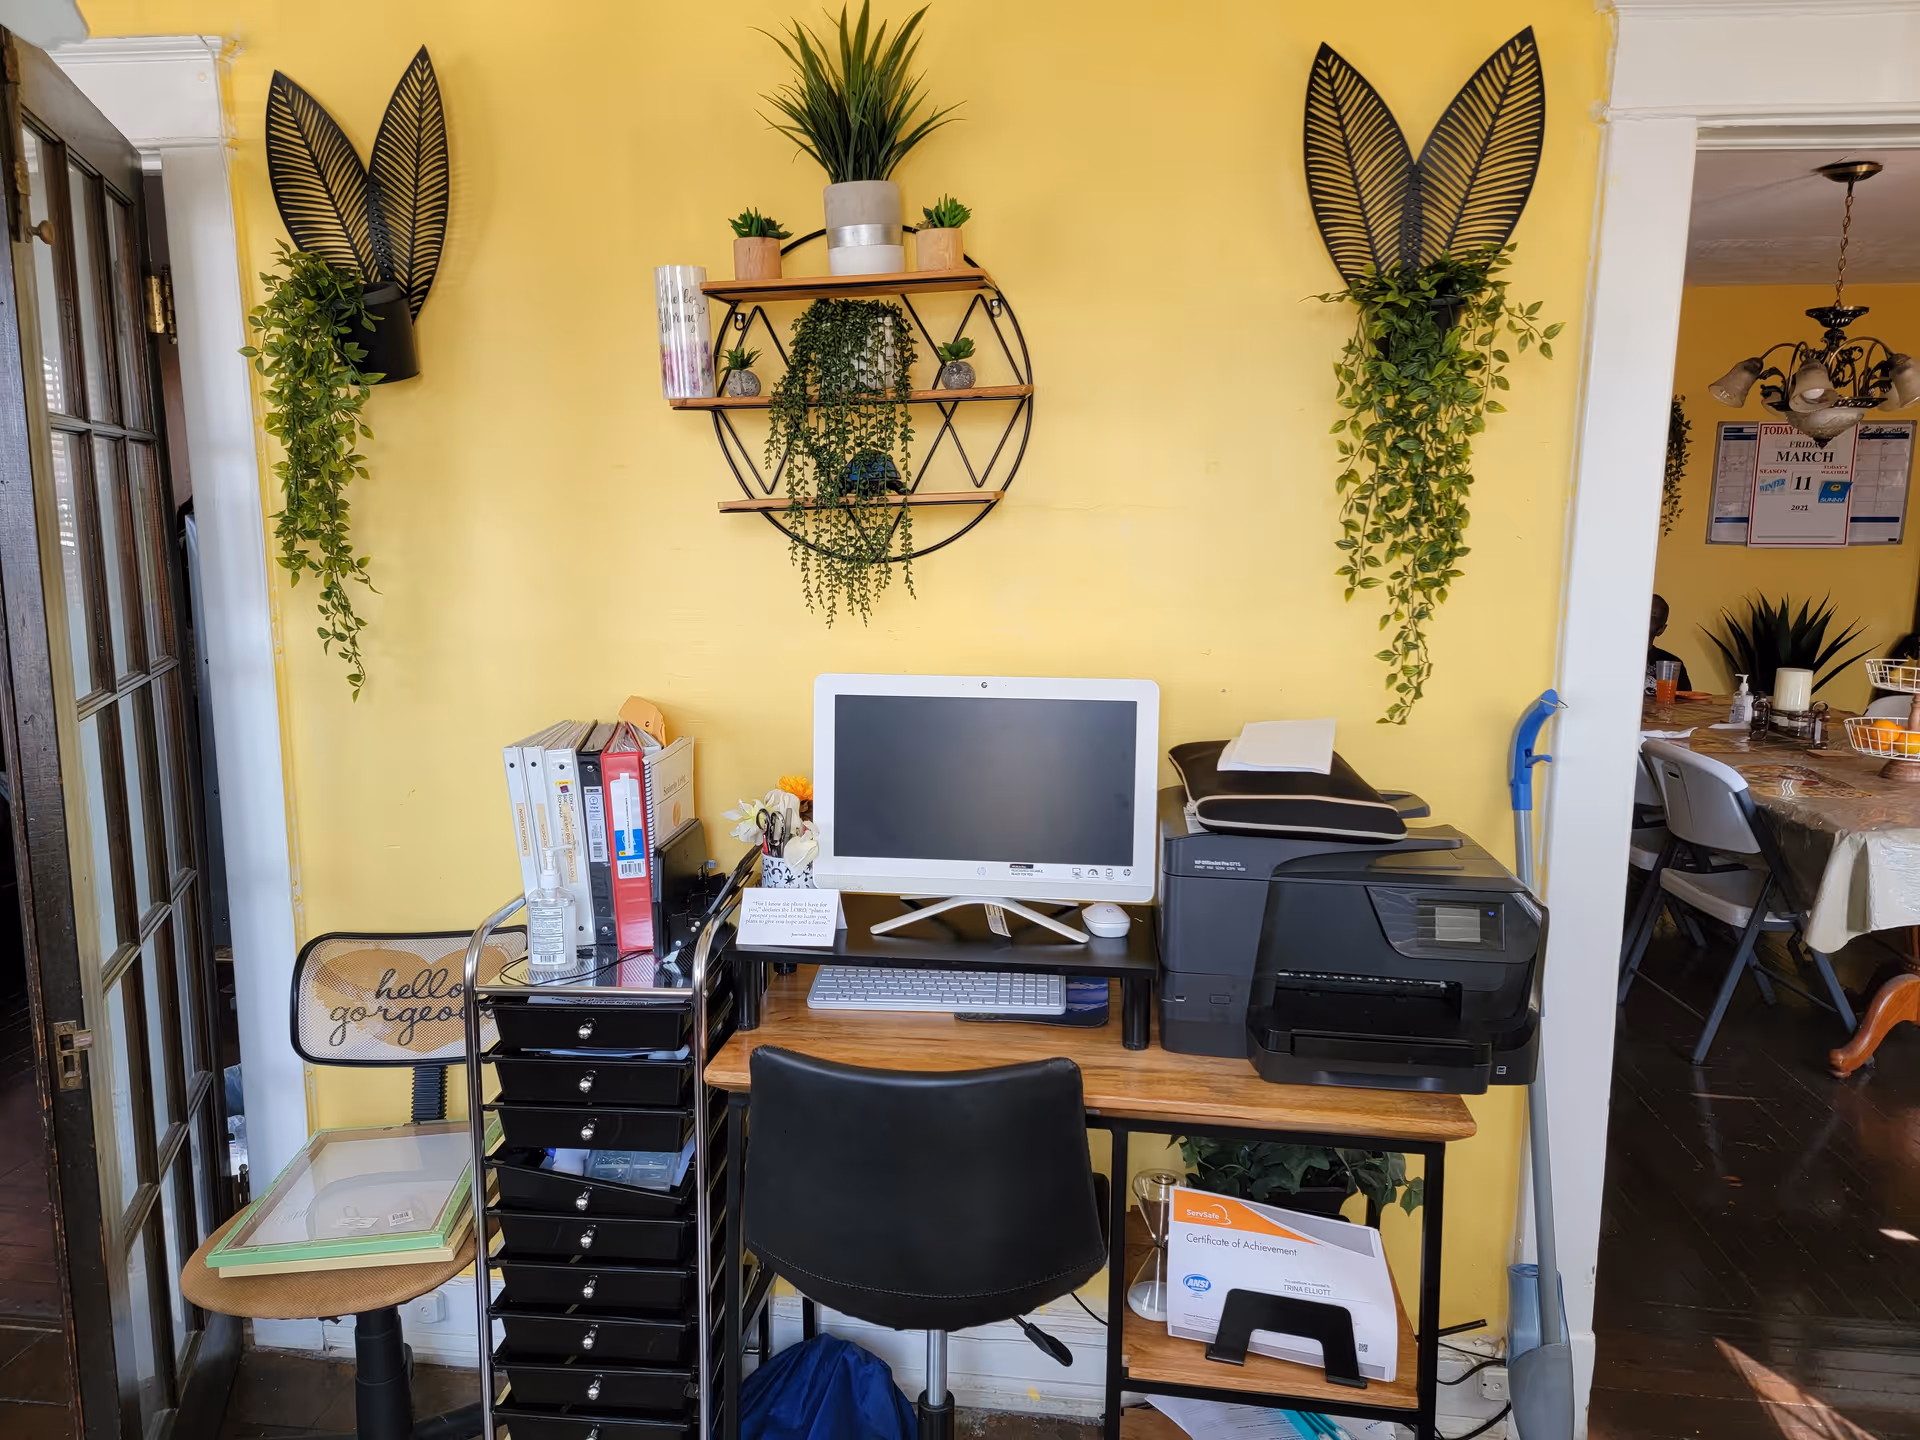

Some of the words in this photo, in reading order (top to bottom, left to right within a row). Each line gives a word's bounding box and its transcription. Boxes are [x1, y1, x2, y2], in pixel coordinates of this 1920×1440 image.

[1763, 426, 1794, 435] TODAY
[1789, 441, 1819, 449] FRIDA
[1776, 451, 1834, 463] MARCH
[1760, 478, 1786, 492] WINTER
[1793, 476, 1811, 491] 11
[375, 968, 464, 999] hello
[1186, 1208, 1219, 1220] ServSafe
[1186, 1233, 1230, 1247] Certificate
[1232, 1239, 1240, 1248] of
[1243, 1240, 1297, 1256] Achievement
[1187, 1278, 1209, 1289] ANSI
[1284, 1284, 1303, 1293] TRINA
[1305, 1287, 1331, 1296] ELLIOTT
